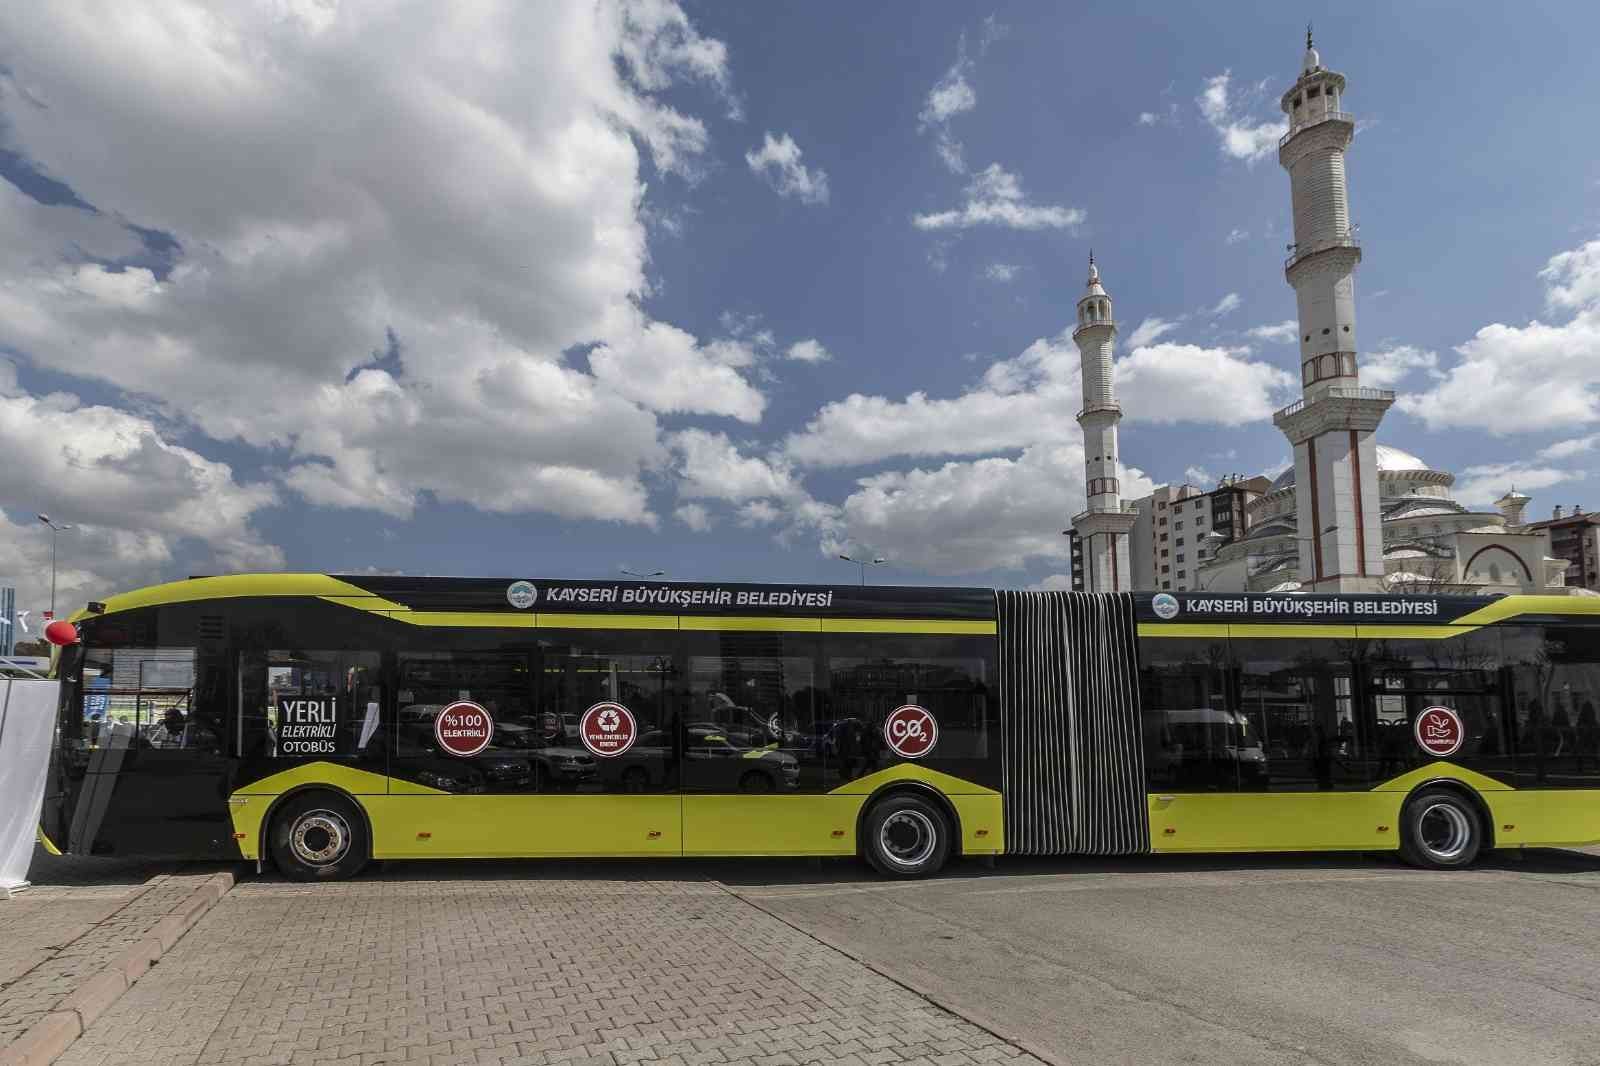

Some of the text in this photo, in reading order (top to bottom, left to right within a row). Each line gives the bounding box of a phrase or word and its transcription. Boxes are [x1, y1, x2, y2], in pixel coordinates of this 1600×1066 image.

[546, 586, 833, 607] KAYSERİ BÜYÜKŞEHİR BELEDİYESİ
[1186, 597, 1437, 616] KAYSERİ BÜYÜKŞEHİR BELEDİYESİ
[282, 697, 336, 722] YERLİ
[445, 714, 482, 727] %100
[282, 723, 336, 738] ELEKTRİKLİ
[443, 728, 485, 737] ELEKTRİKLİ
[283, 740, 336, 753] OTOBÜS
